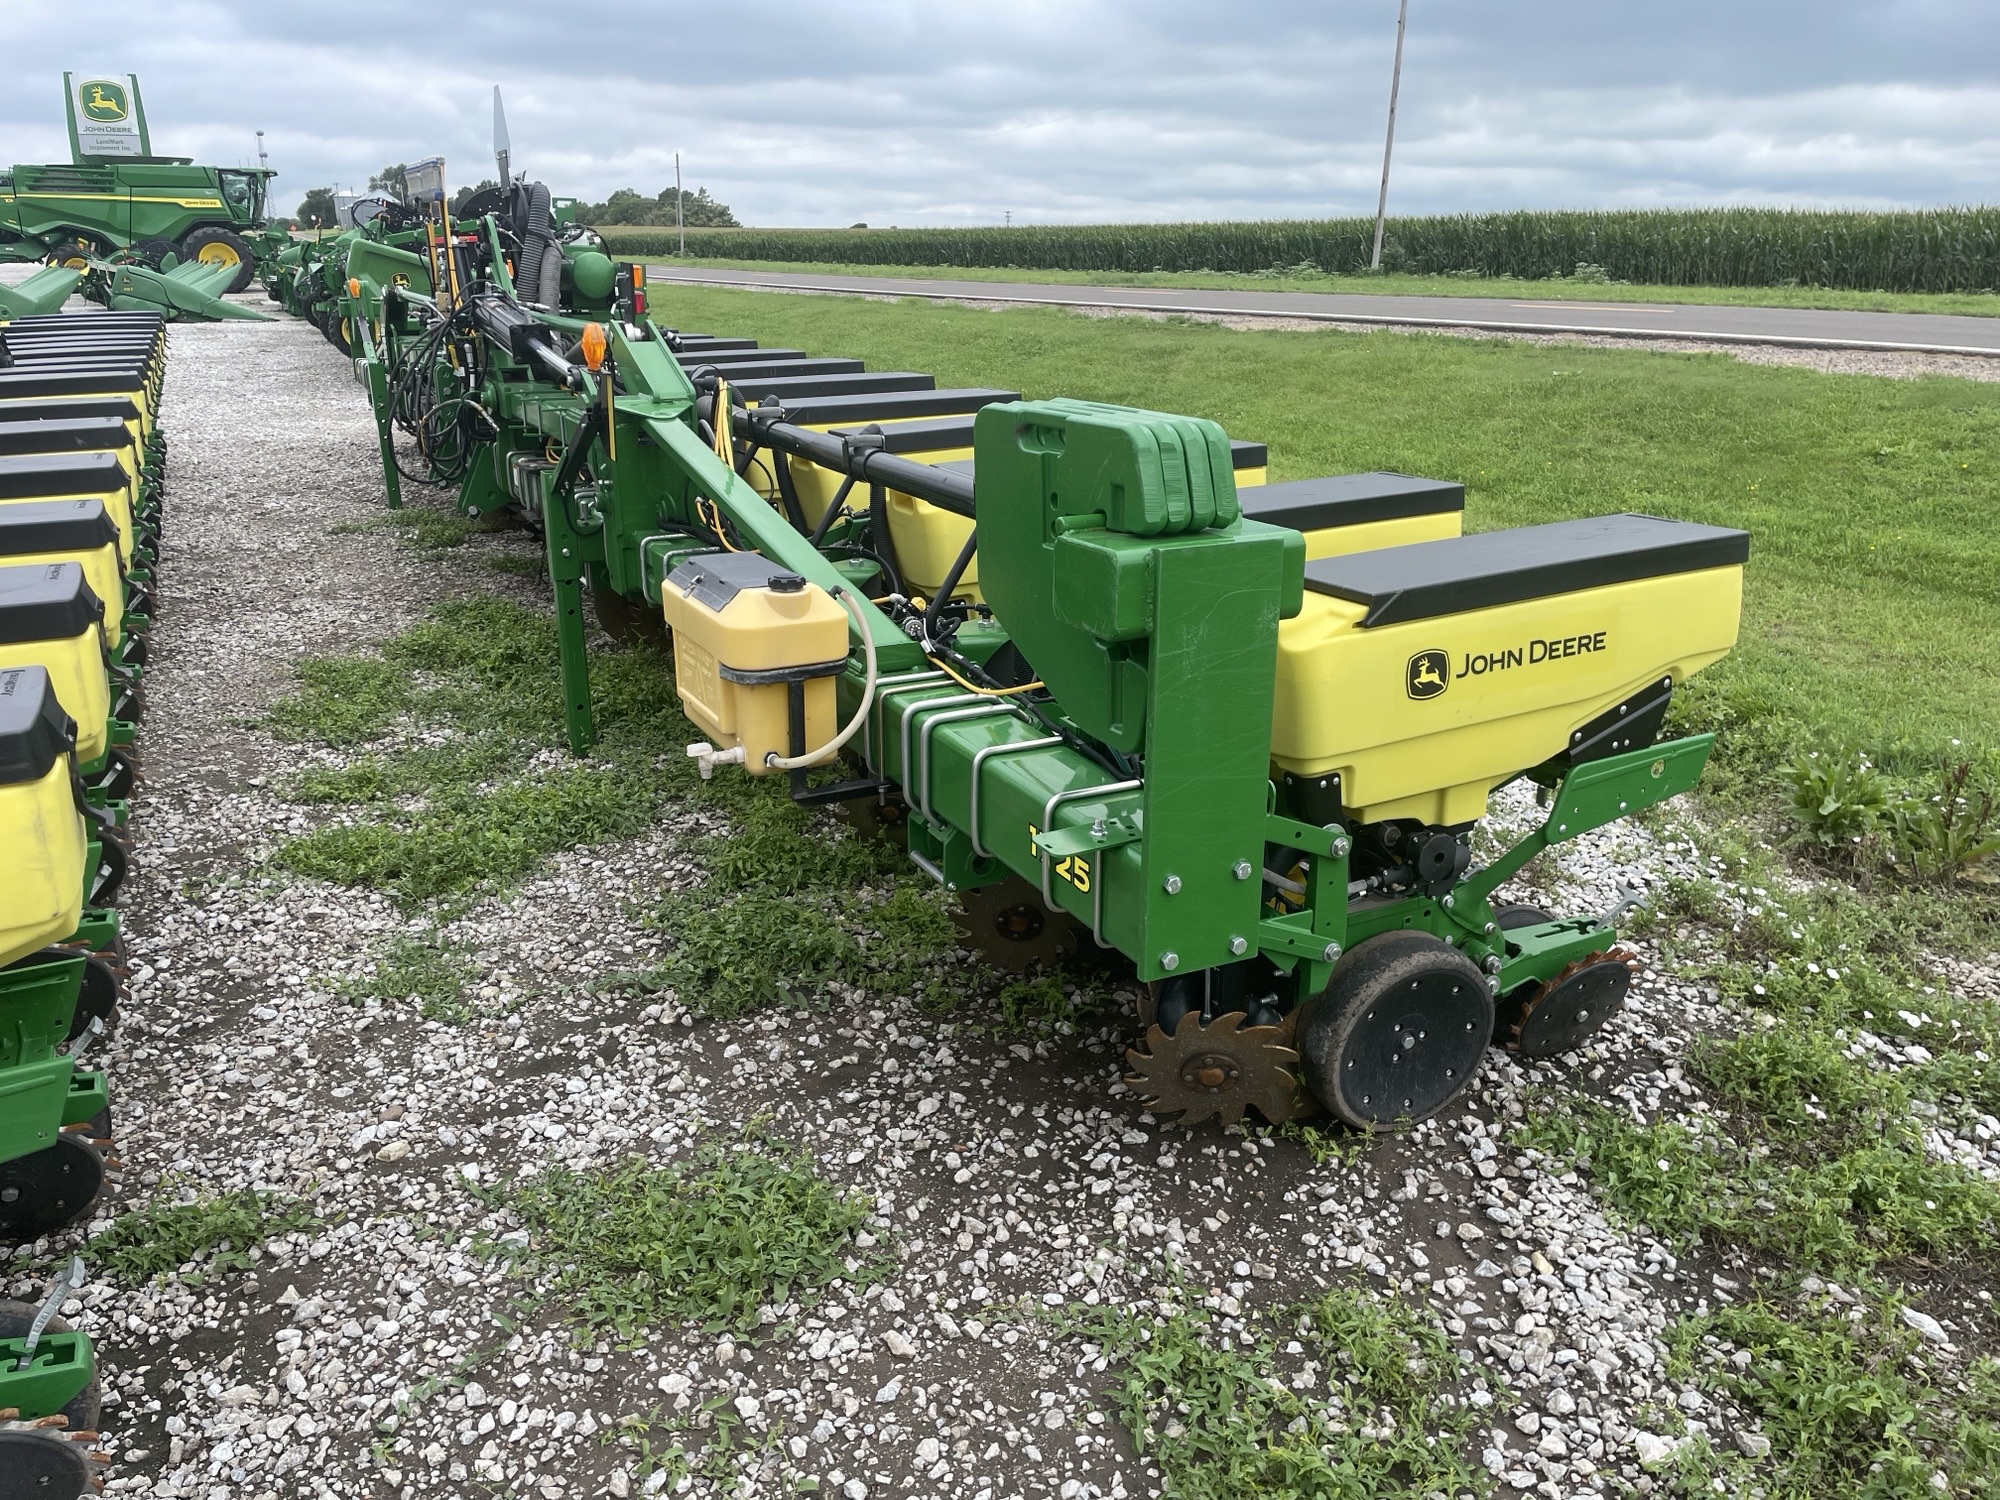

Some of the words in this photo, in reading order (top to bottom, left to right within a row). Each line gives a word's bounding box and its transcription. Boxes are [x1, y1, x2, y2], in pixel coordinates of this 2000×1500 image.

[1456, 648, 1523, 679] JOHN
[1529, 631, 1607, 664] DEERE
[1028, 822, 1090, 893] 125
